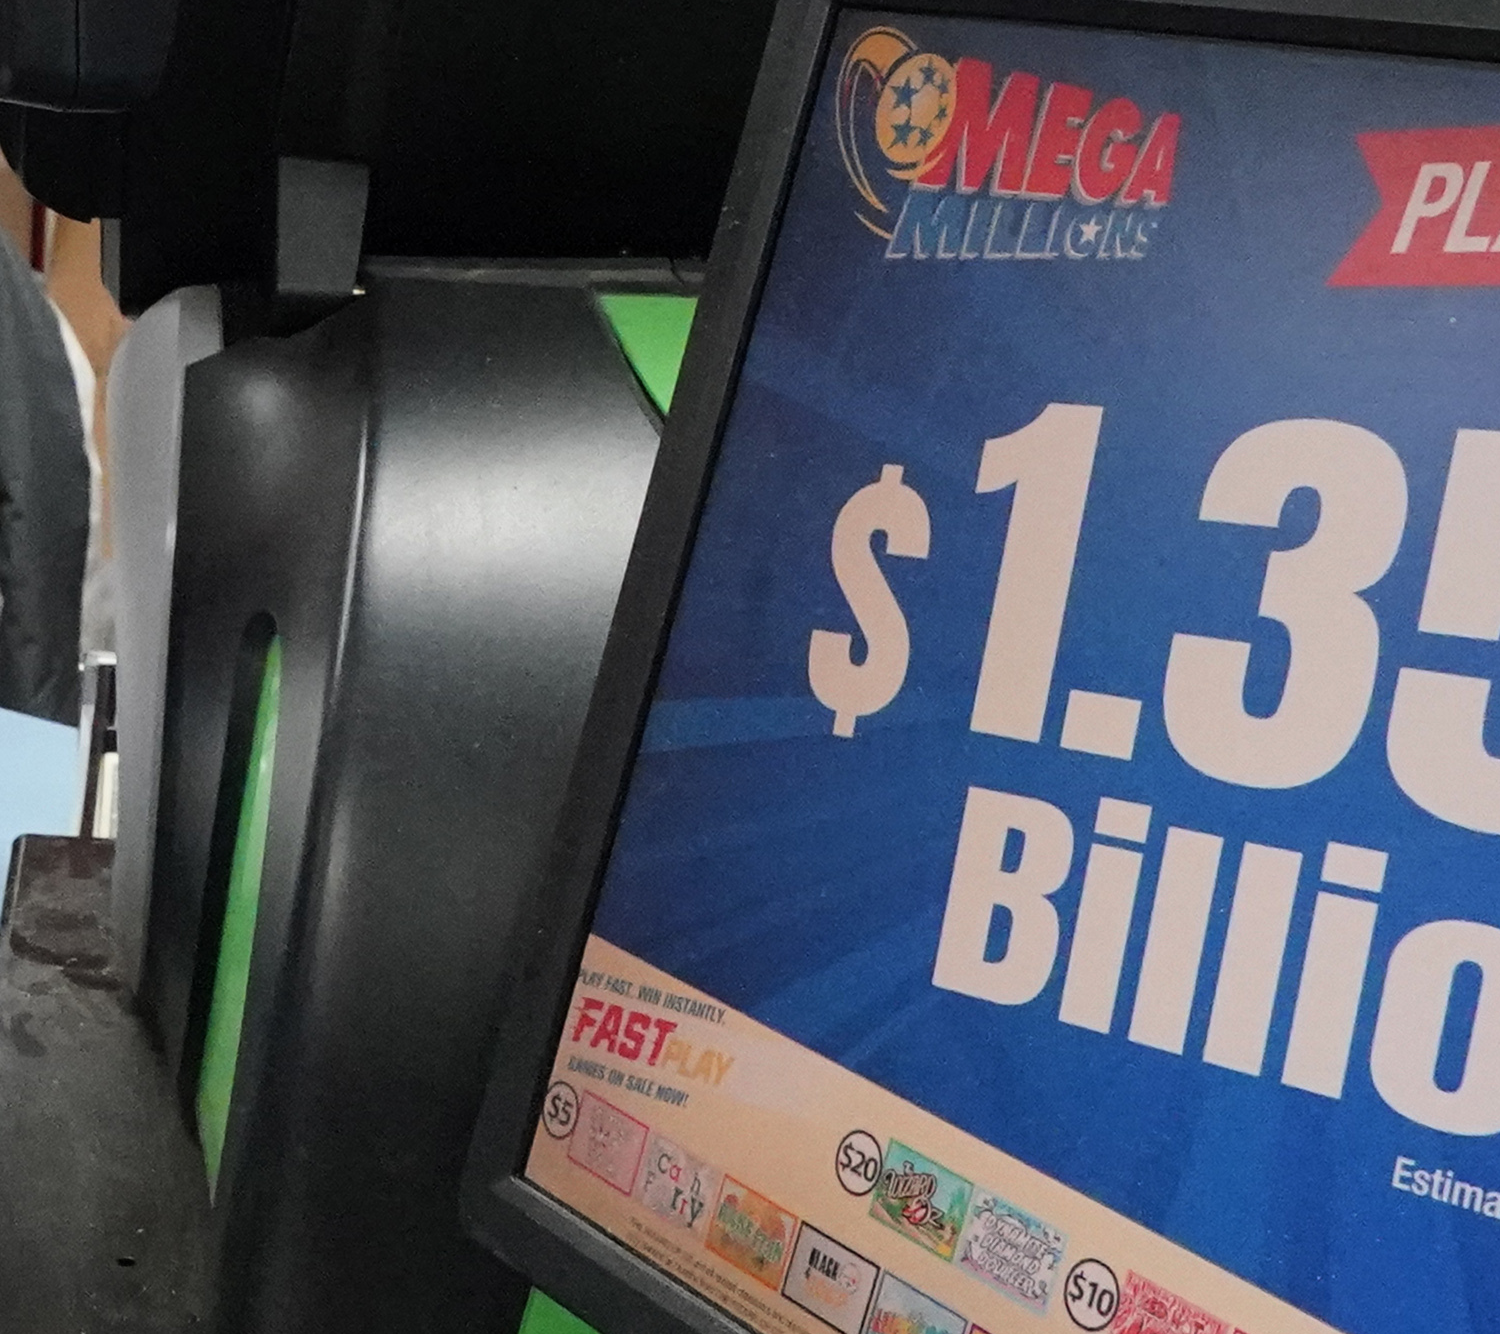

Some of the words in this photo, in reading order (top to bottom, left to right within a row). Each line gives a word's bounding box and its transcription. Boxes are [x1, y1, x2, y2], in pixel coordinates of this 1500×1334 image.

[930, 55, 1182, 209] MEGA
[885, 190, 1160, 263] MILLIONS
[638, 982, 662, 1005] WIN
[608, 1066, 623, 1090] ON
[623, 1071, 654, 1097] SALE
[655, 1080, 688, 1108] NOW!
[548, 1097, 571, 1125] $5
[838, 1146, 878, 1182] $20
[980, 1231, 1041, 1276] DIAMOND
[1069, 1273, 1115, 1318] $10
